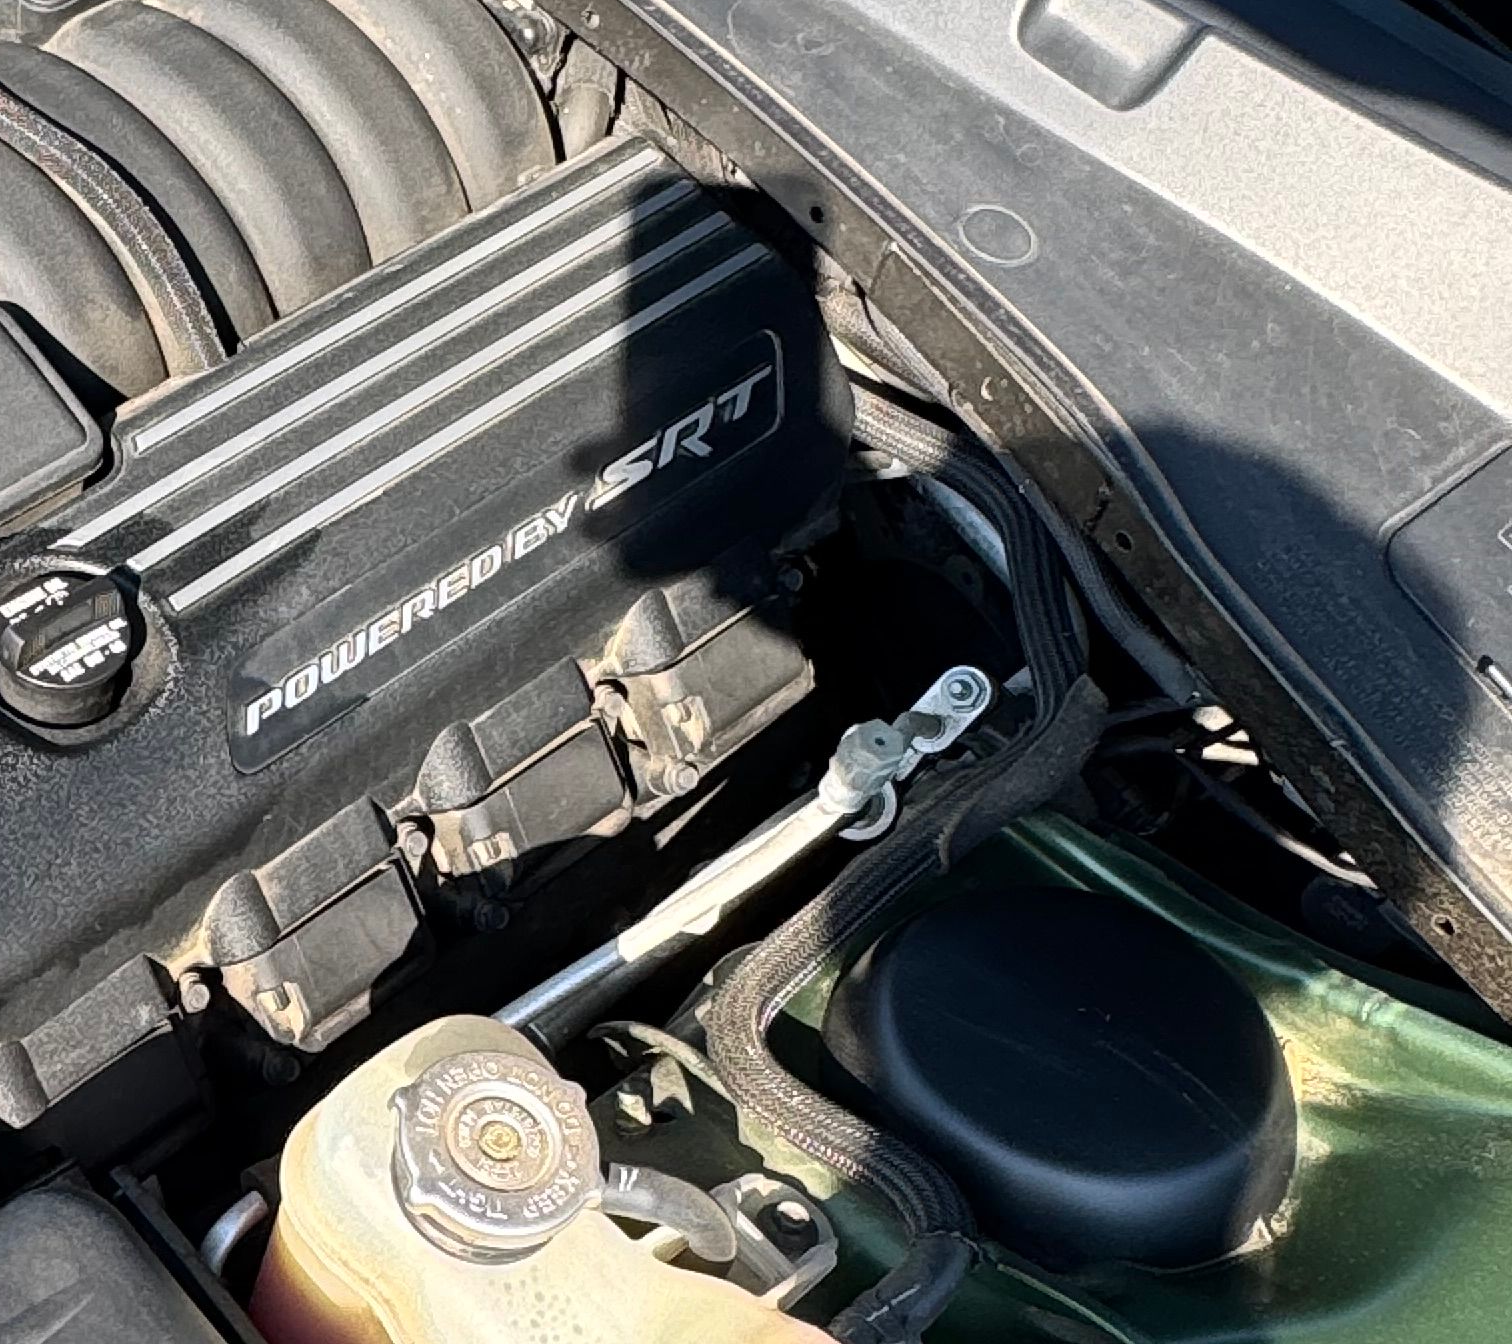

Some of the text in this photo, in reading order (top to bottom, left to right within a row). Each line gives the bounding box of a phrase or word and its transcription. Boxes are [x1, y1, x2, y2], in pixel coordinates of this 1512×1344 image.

[245, 544, 504, 736] POWERED
[512, 492, 578, 560] BY
[586, 362, 773, 511] SRT
[439, 1060, 501, 1096] OPEN
[506, 1066, 557, 1101] NOT
[522, 1168, 580, 1219] KEEP
